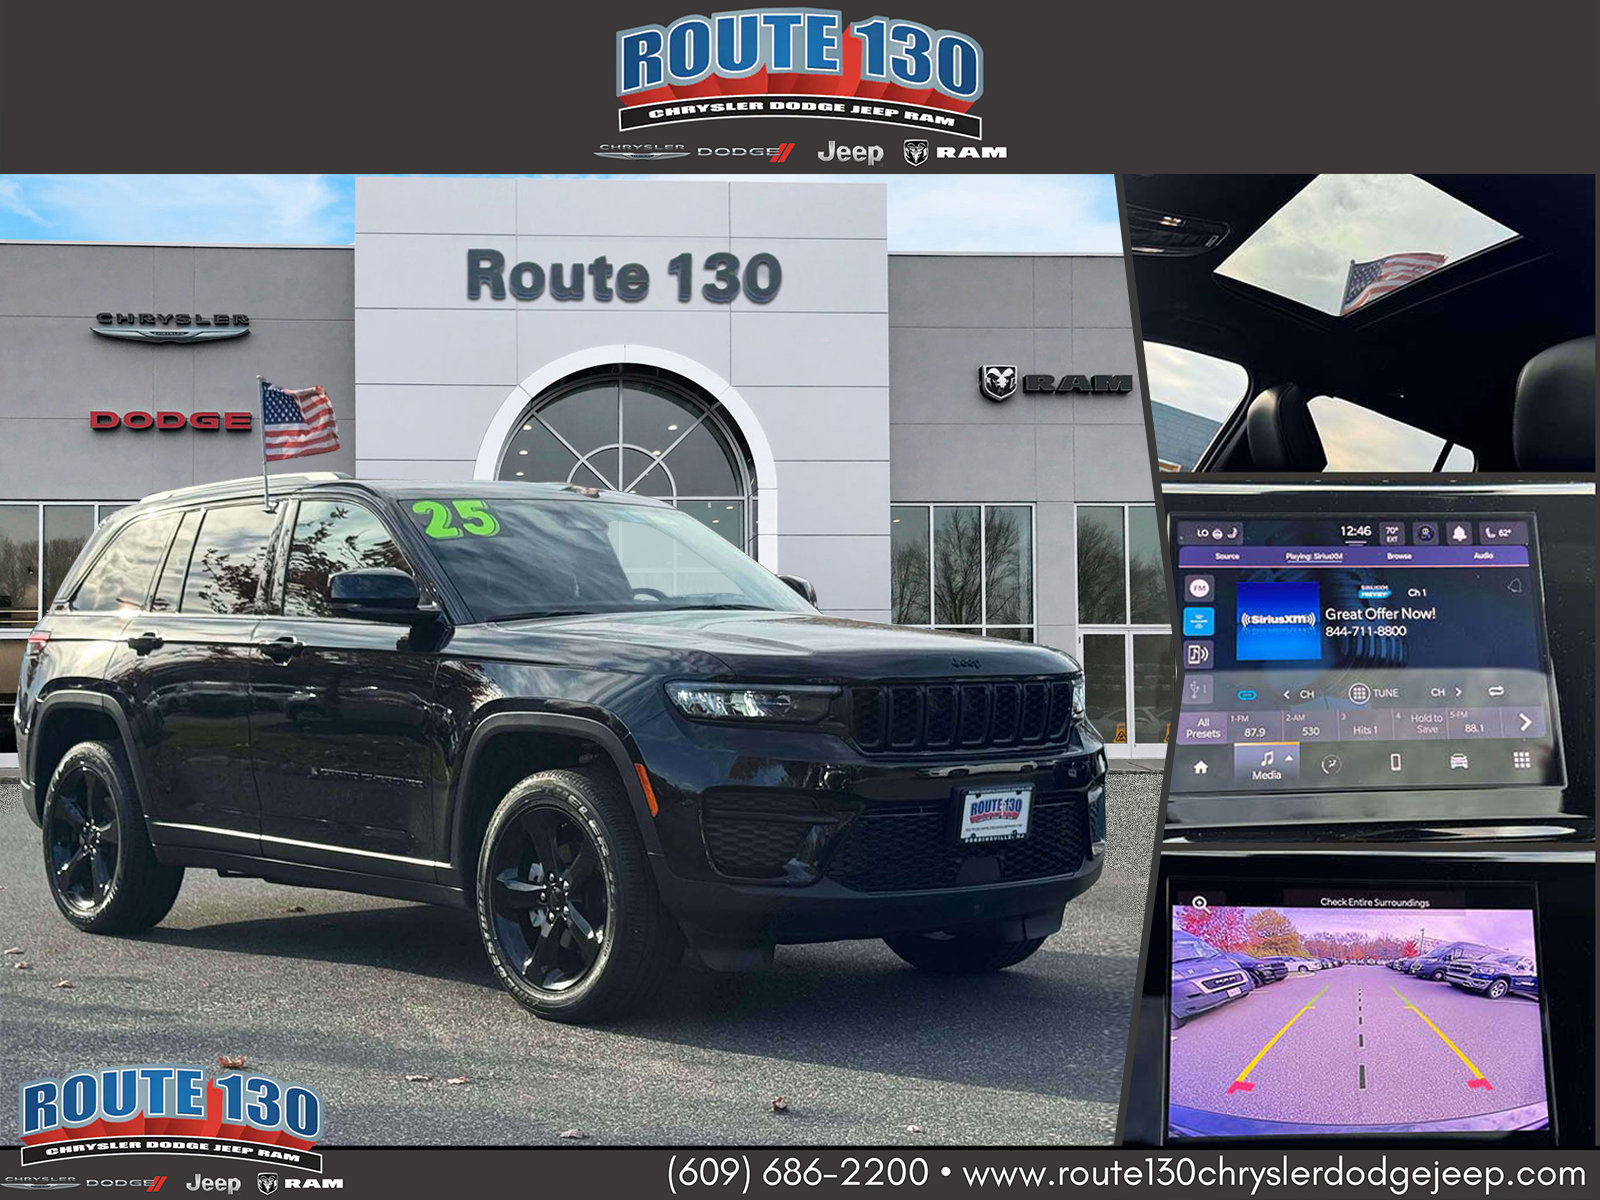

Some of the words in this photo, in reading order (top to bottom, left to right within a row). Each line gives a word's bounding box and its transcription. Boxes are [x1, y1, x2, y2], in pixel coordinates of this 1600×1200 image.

[467, 248, 650, 303] Route
[668, 252, 783, 304] 130
[96, 312, 250, 326] CHRYSLER
[1023, 374, 1133, 394] RAM
[90, 411, 252, 431] DODGE
[412, 500, 500, 539] 25
[1197, 528, 1209, 537] LO
[1340, 525, 1372, 537] 12:46
[1386, 535, 1399, 543] EXT
[1215, 552, 1240, 561] Source
[1286, 552, 1313, 562] Playing:
[1313, 552, 1344, 561] SiriusXM
[1387, 552, 1412, 561] Browse
[1474, 551, 1494, 560] Audio
[1193, 584, 1207, 592] FM
[1408, 588, 1421, 597] Ch
[1422, 588, 1427, 597] 1
[1325, 607, 1363, 621] Great
[1364, 607, 1399, 621] Offer
[1401, 607, 1436, 620] Now!
[1325, 625, 1407, 637] 844-711-8800
[1299, 690, 1315, 699] CH
[1373, 688, 1399, 698] TUNE
[1430, 687, 1446, 697] CH
[1197, 718, 1210, 727] All
[1230, 714, 1249, 722] 1-FM
[1410, 713, 1433, 723] Hold
[1433, 713, 1443, 723] to
[1244, 727, 1266, 738] 87.9
[1302, 726, 1320, 736] 530
[1353, 725, 1372, 735] Hits
[1373, 725, 1378, 734] 1
[1417, 725, 1439, 734] Save
[1464, 724, 1484, 733] 88.1
[1186, 729, 1221, 739] Presets
[1252, 770, 1282, 780] Media
[970, 798, 1003, 816] ROUTE
[1004, 798, 1023, 813] 130
[1320, 896, 1346, 907] Check
[1348, 897, 1373, 907] Entire
[1374, 897, 1431, 909] Surroundings
